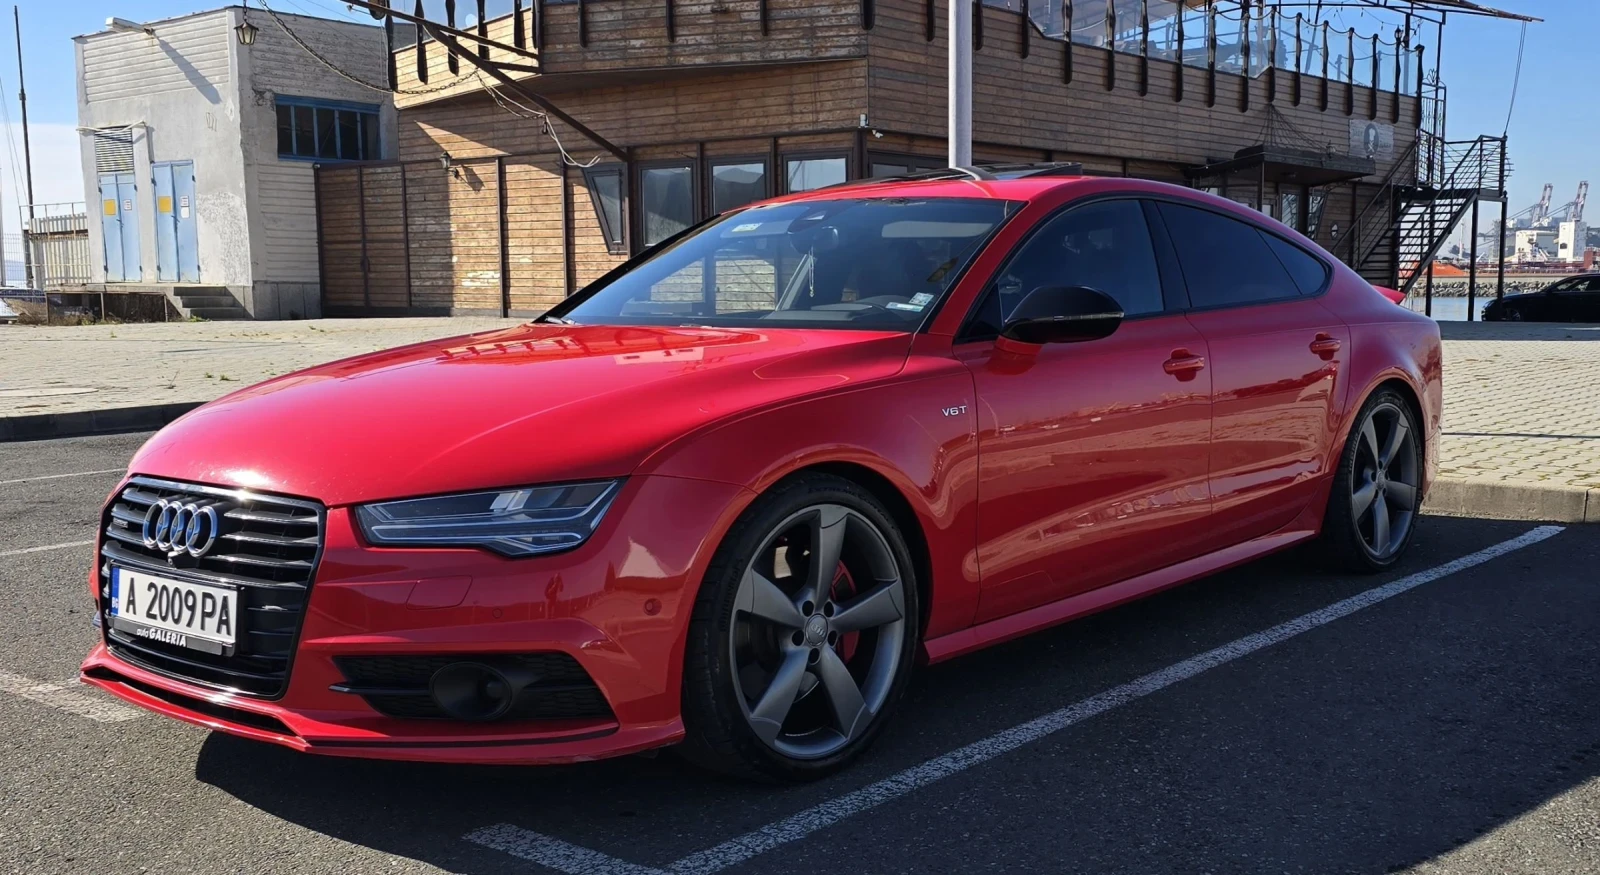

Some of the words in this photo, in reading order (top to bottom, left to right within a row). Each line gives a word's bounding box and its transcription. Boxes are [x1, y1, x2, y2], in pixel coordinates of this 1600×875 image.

[941, 405, 967, 417] V6T
[125, 577, 137, 615] A
[146, 582, 197, 628] 2009
[200, 591, 232, 637] PA
[149, 627, 187, 648] GALERIA
